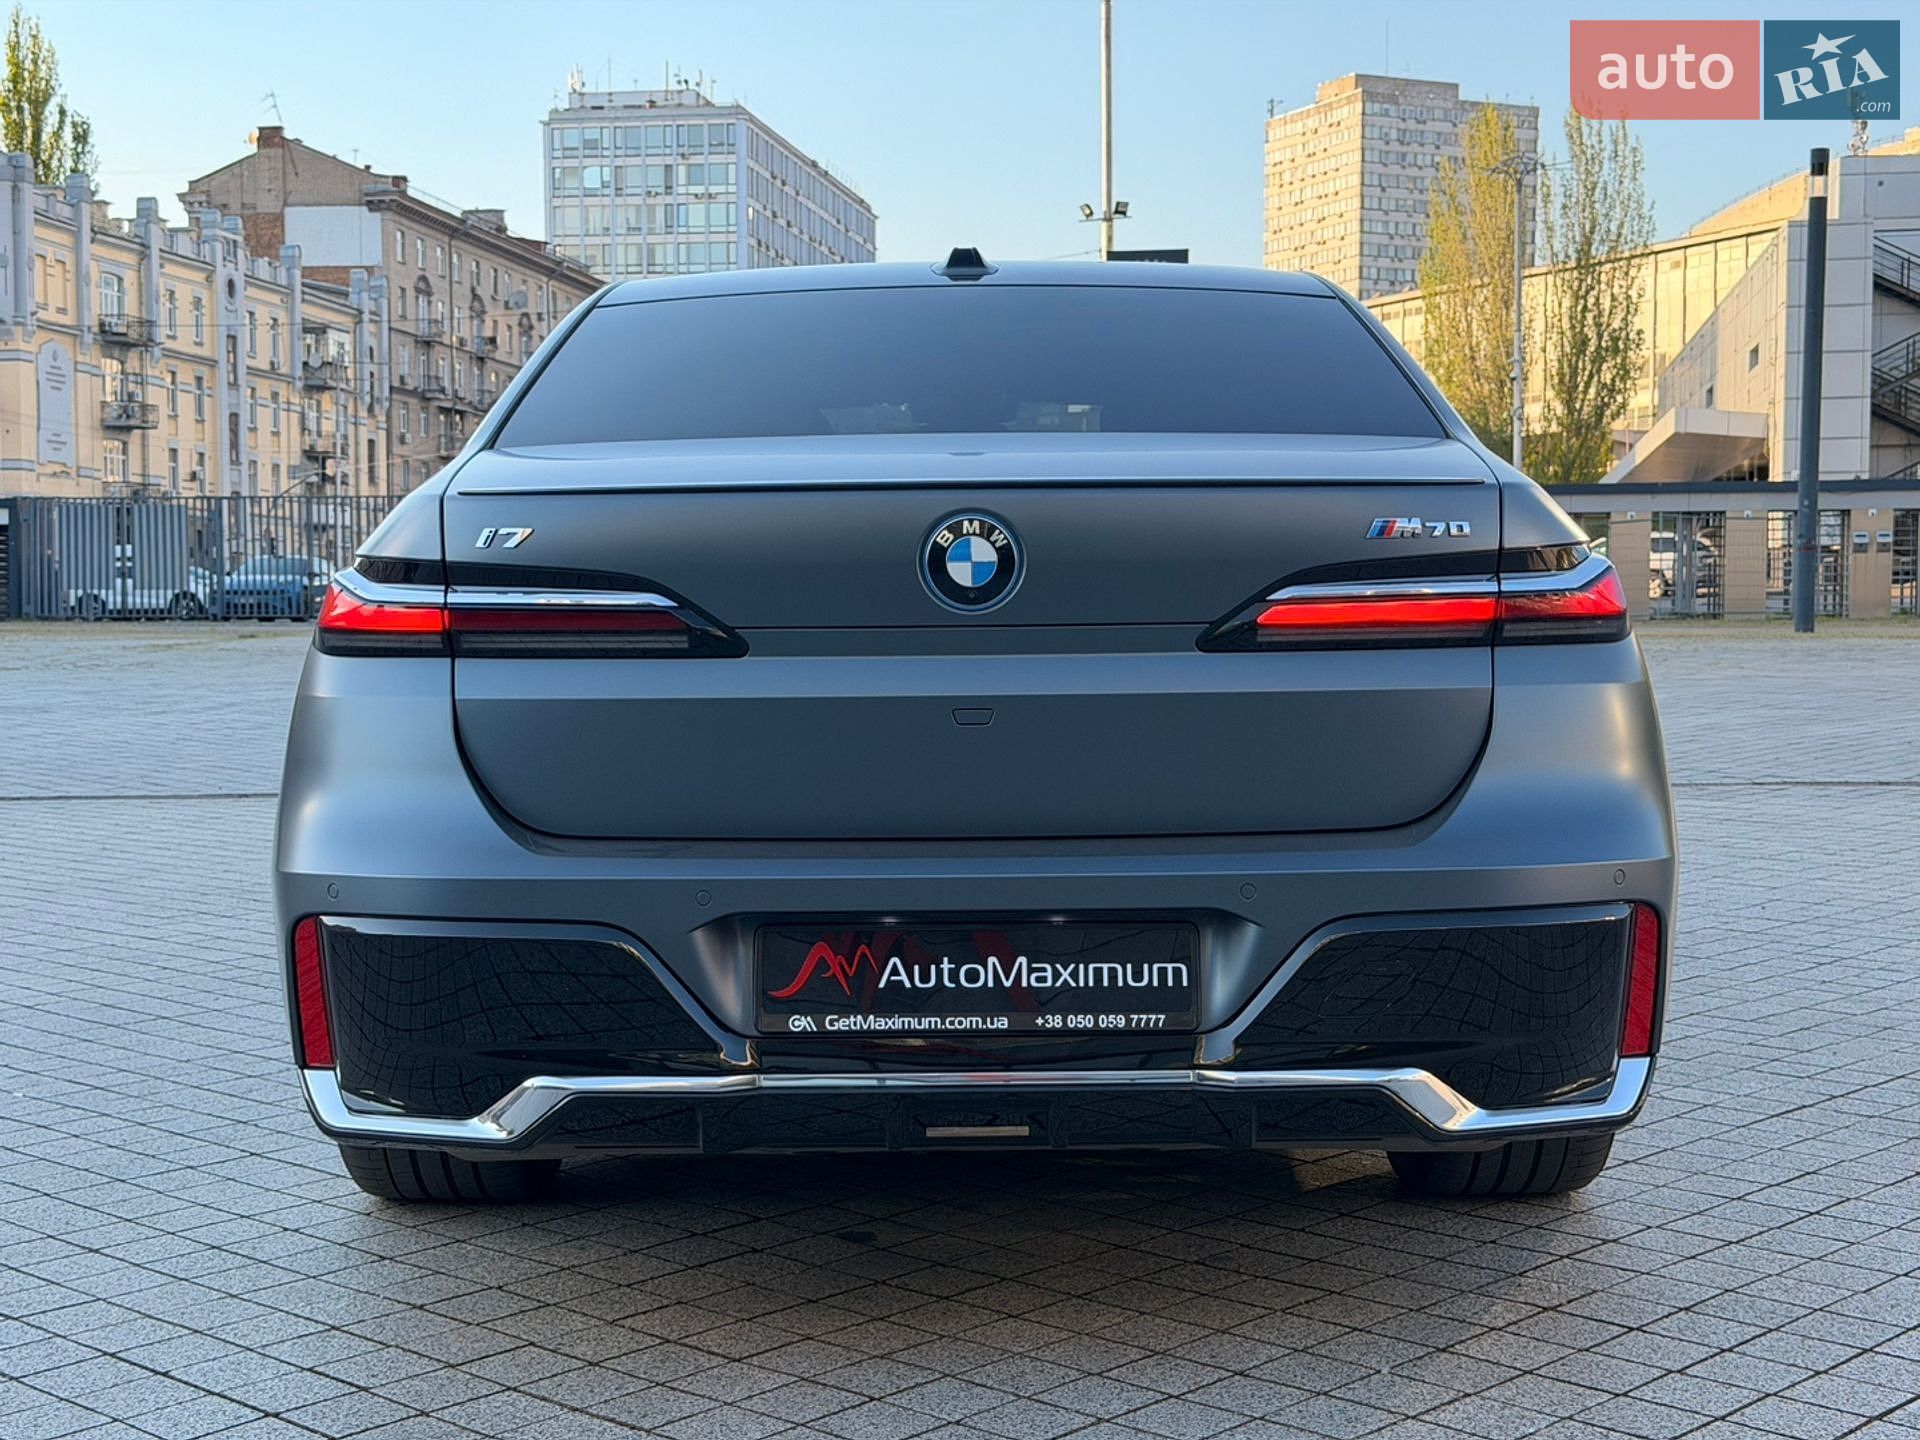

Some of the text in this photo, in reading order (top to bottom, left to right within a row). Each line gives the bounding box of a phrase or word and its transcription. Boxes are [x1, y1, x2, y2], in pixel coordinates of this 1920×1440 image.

[475, 527, 535, 549] i7
[935, 519, 1009, 549] BMW
[878, 956, 1189, 989] AutoMaximum
[825, 1014, 1009, 1030] GetMaximum.com.ua
[1035, 1014, 1166, 1029] +38 050 059 7777
